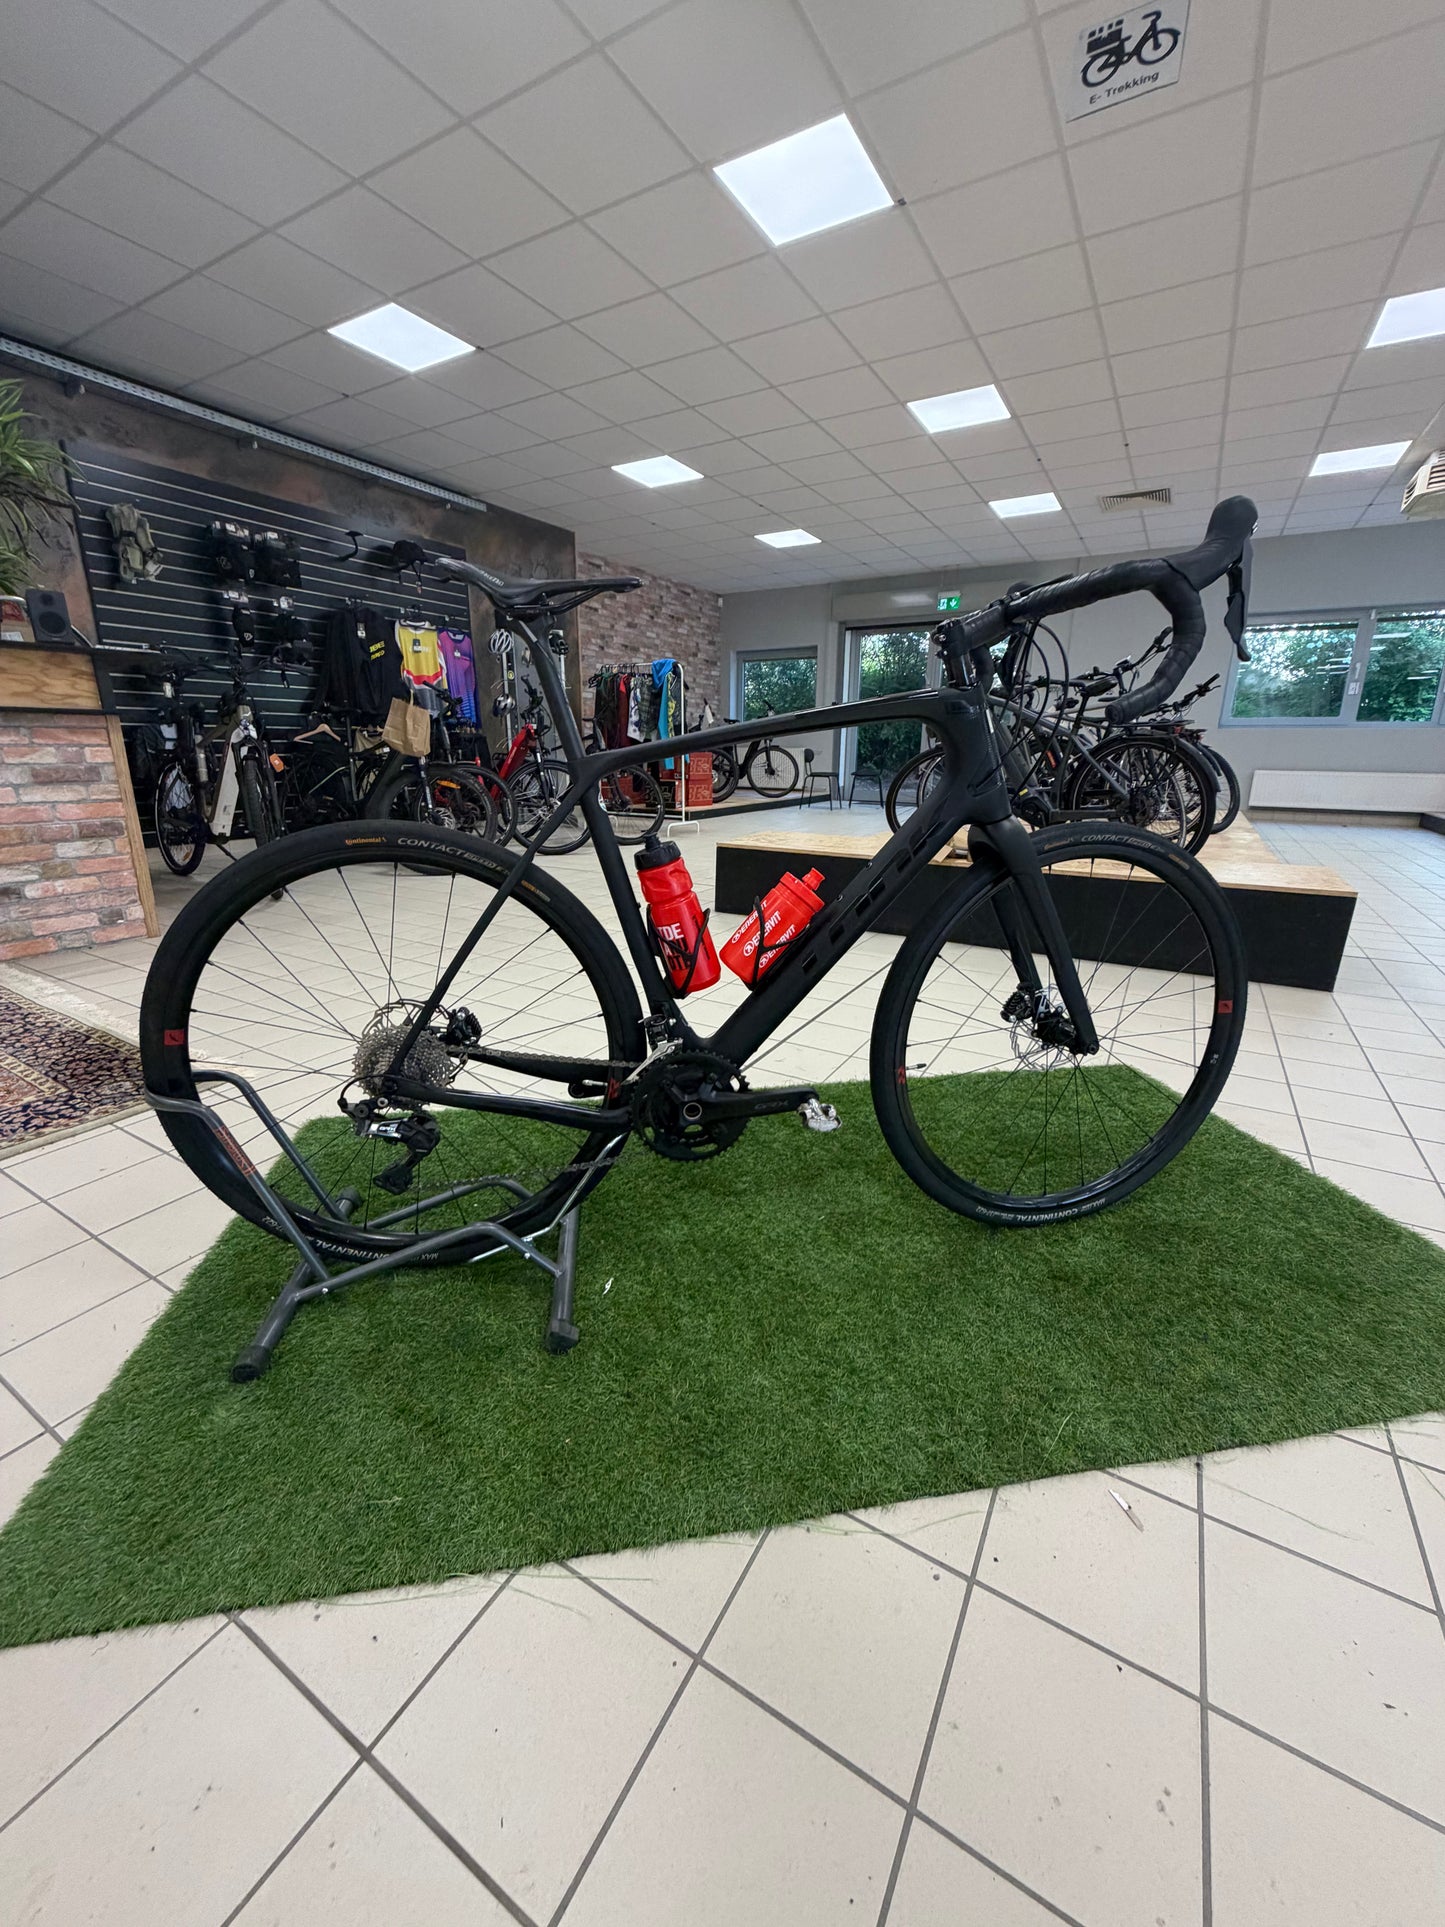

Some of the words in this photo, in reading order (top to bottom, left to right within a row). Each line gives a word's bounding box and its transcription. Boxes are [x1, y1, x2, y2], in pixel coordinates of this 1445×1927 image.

[1105, 72, 1160, 98] Trekking
[397, 837, 464, 856] CONTACT
[1081, 834, 1130, 844] CONTACT
[1016, 1208, 1078, 1222] CONTINENTAL
[316, 1239, 391, 1260] ONTINENTAL
